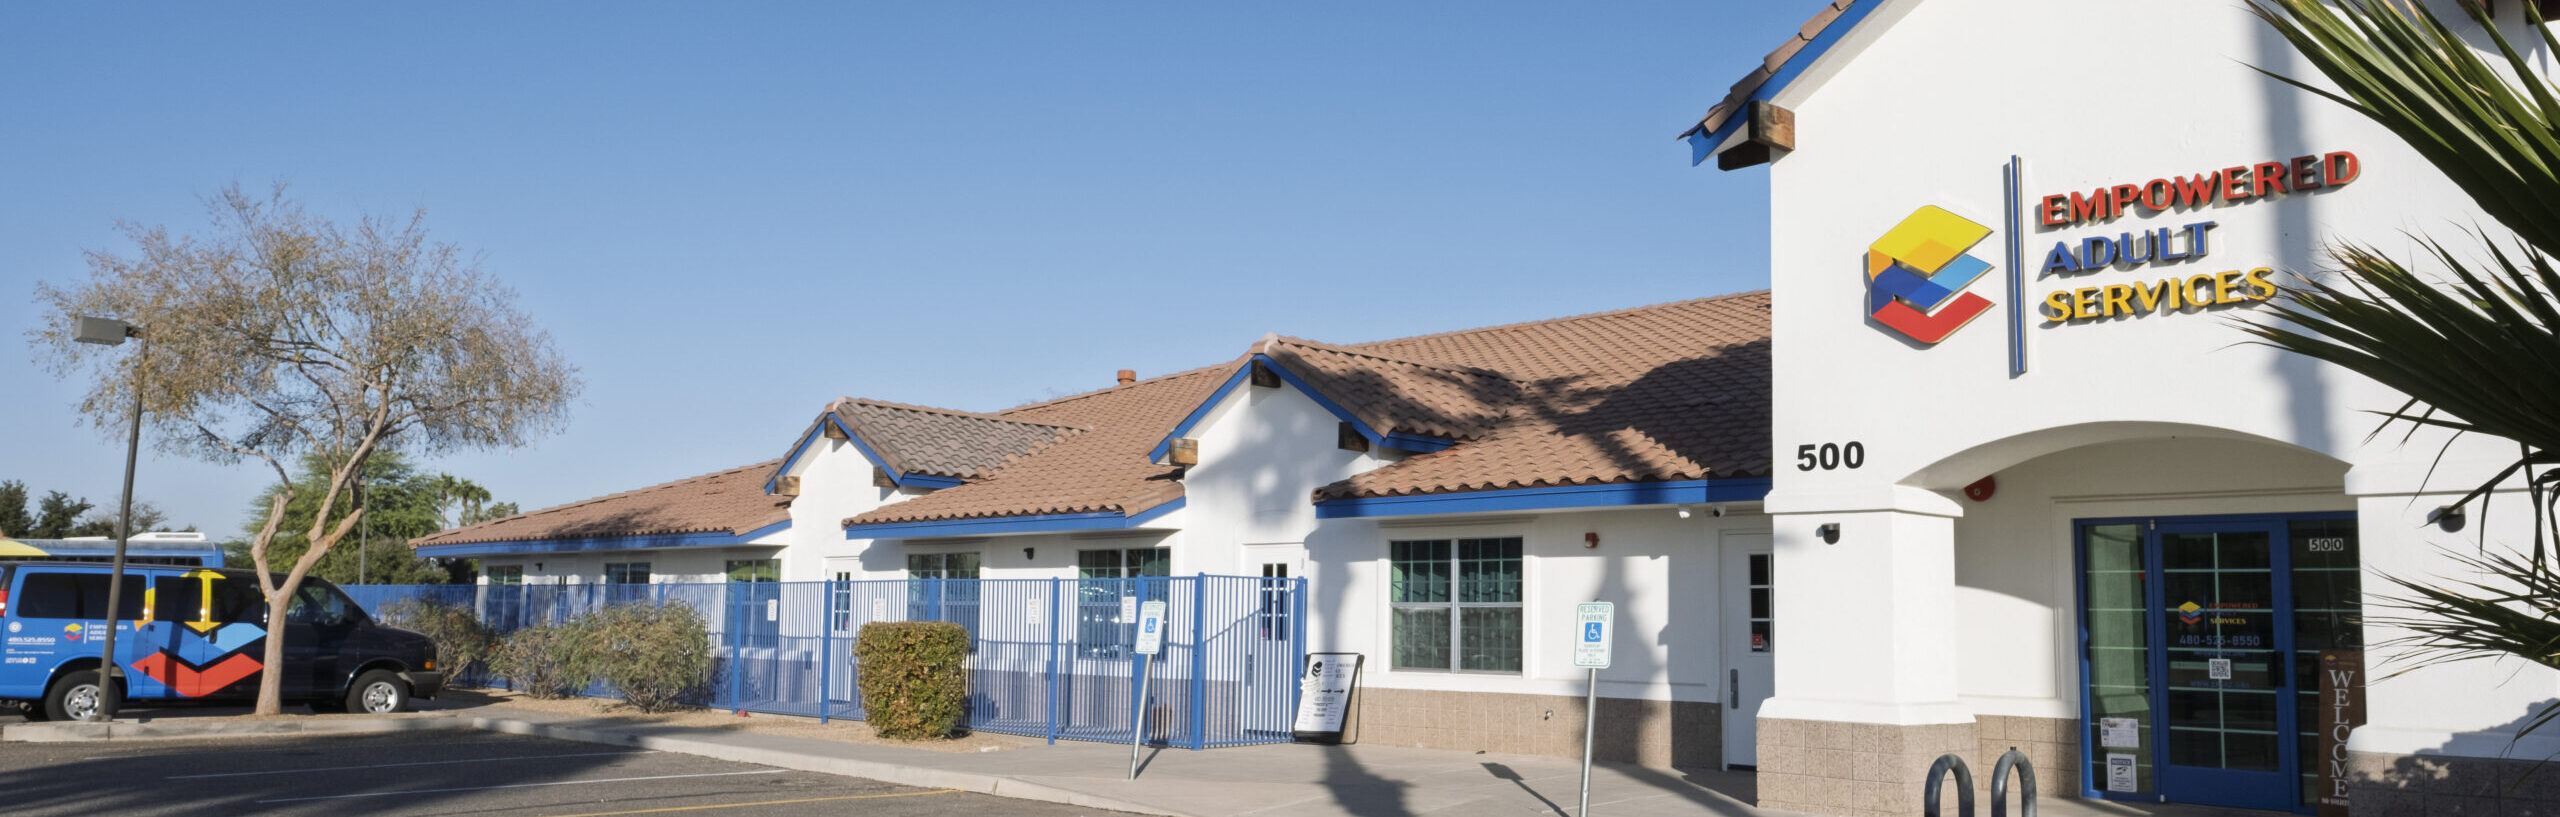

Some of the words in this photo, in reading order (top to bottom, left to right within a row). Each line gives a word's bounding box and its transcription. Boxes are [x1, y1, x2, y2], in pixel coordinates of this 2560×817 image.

[2043, 151, 2360, 225] EMPOWERED
[2046, 221, 2218, 273] ADULT
[2046, 267, 2278, 322] SERVICES
[1797, 441, 1865, 472] 500
[2310, 538, 2343, 551] 500
[2328, 669, 2355, 798] WELCOME
